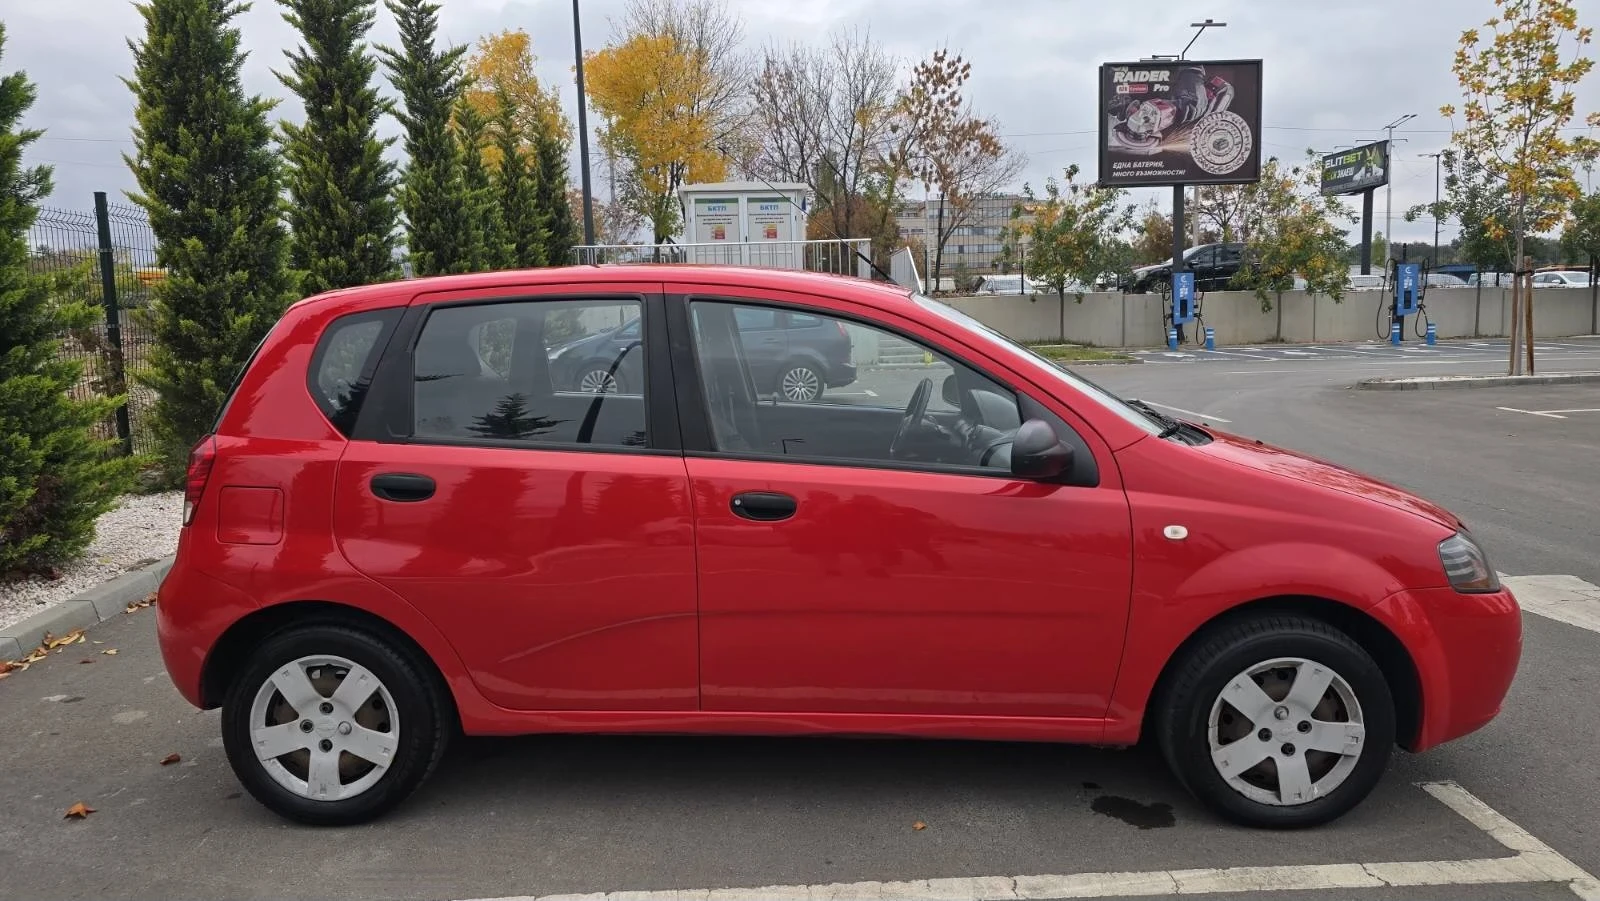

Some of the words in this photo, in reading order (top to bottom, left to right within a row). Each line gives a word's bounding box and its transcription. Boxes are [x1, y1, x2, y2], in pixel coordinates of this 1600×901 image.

[1113, 70, 1170, 83] RAIDER
[1153, 84, 1170, 92] Pro
[1112, 162, 1132, 170] ЕДНА
[1132, 161, 1165, 169] БАТЕРИЯ,
[1325, 151, 1363, 169] ELITBET
